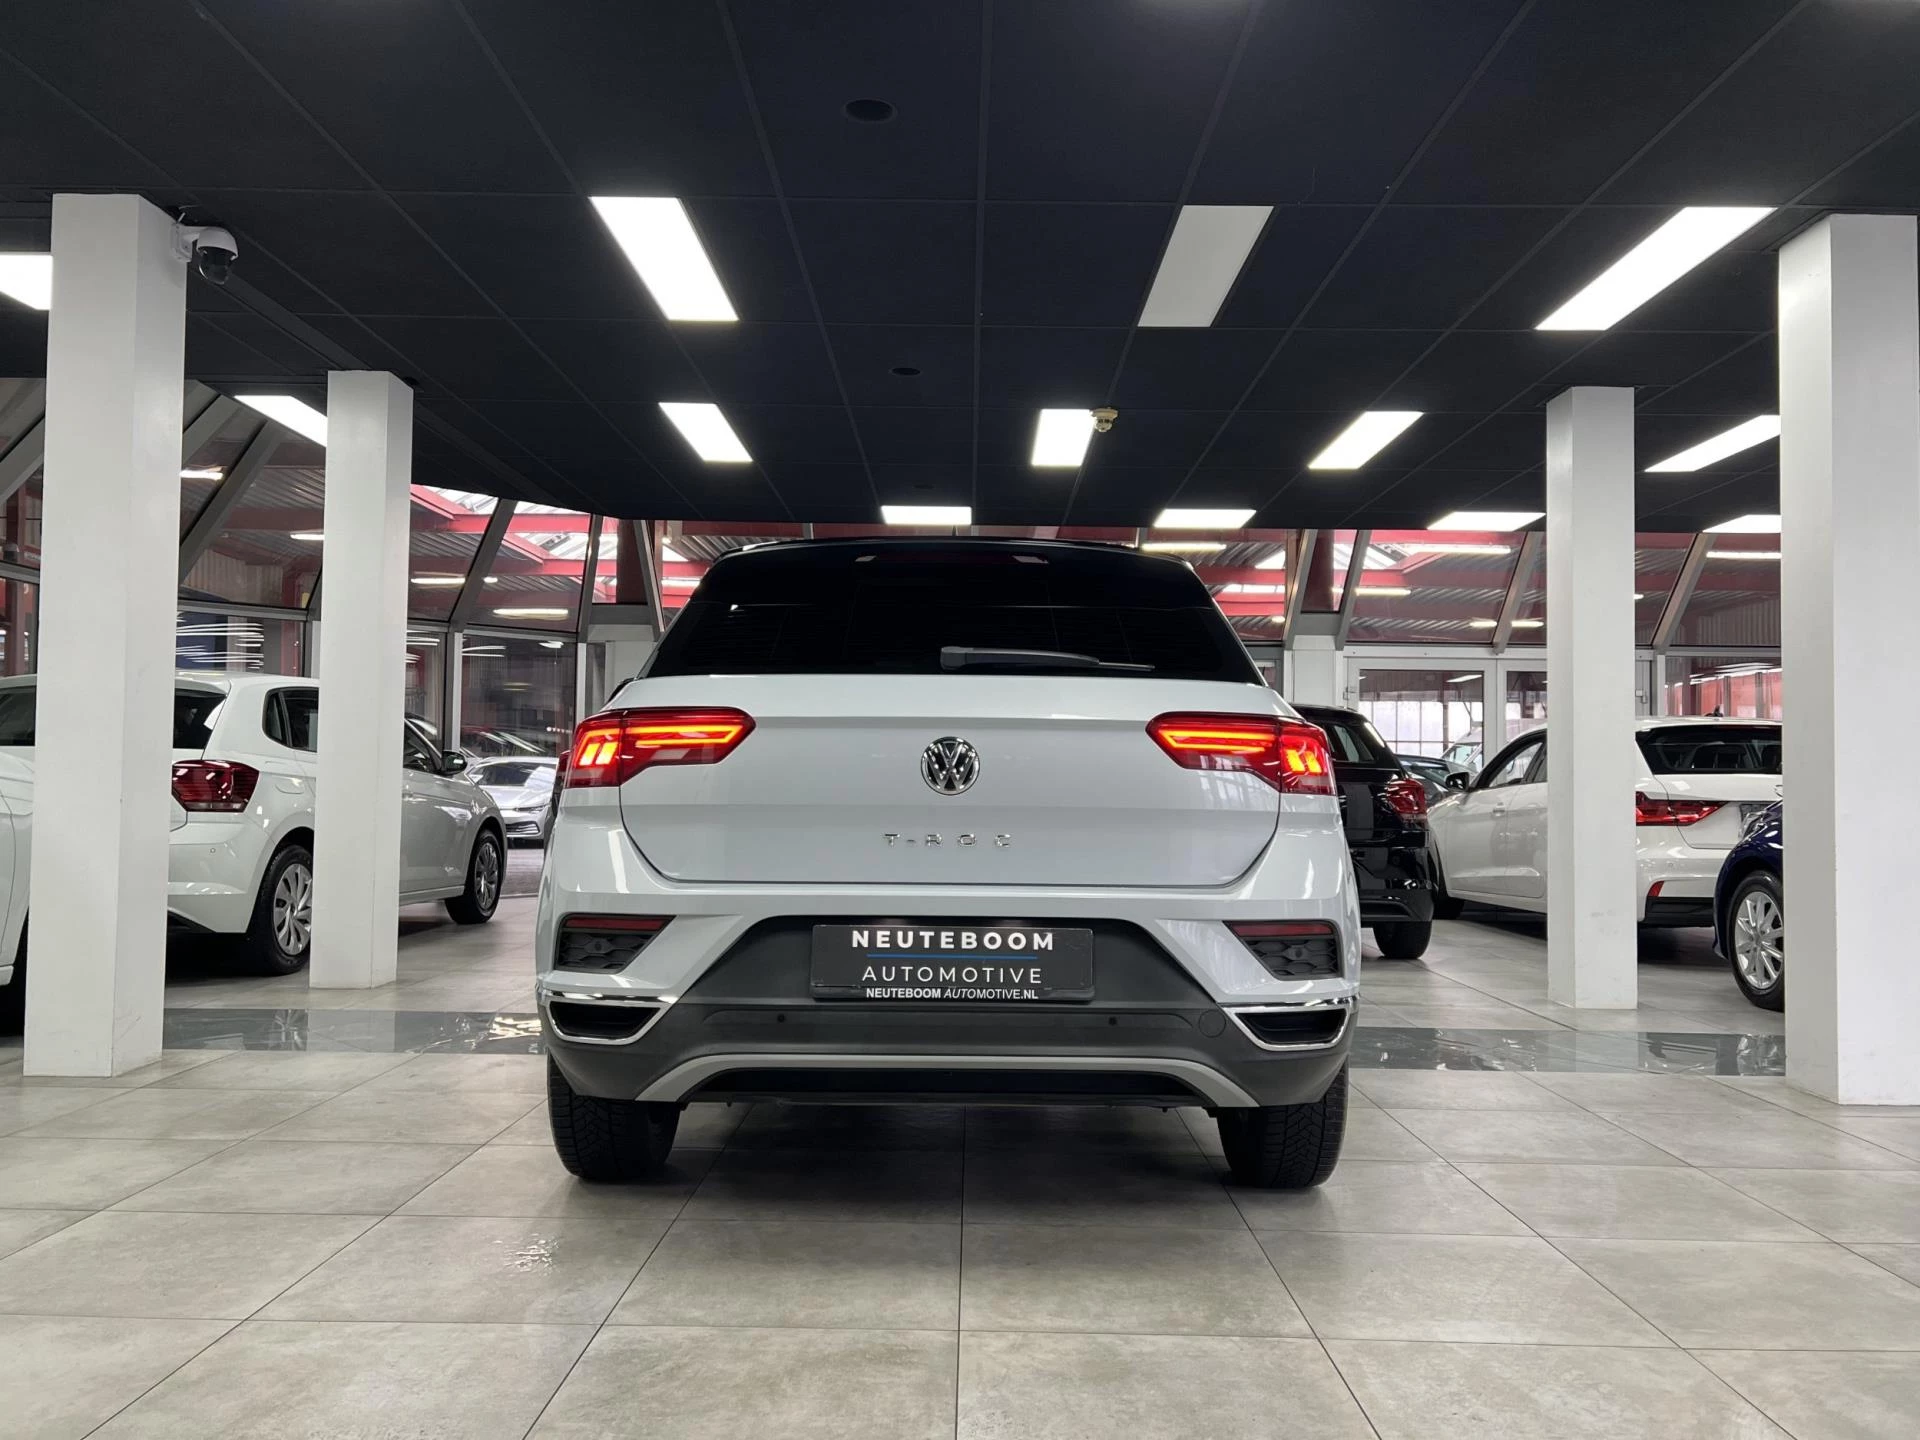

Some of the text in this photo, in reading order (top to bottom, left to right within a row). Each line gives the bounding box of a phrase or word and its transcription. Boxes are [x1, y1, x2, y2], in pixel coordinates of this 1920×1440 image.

[852, 930, 1053, 950] NEUTEBOOM
[862, 966, 1042, 984] AUTOMOTIVE
[866, 987, 1039, 999] NEUTEBOOM AUTOMOTIVE.NL
